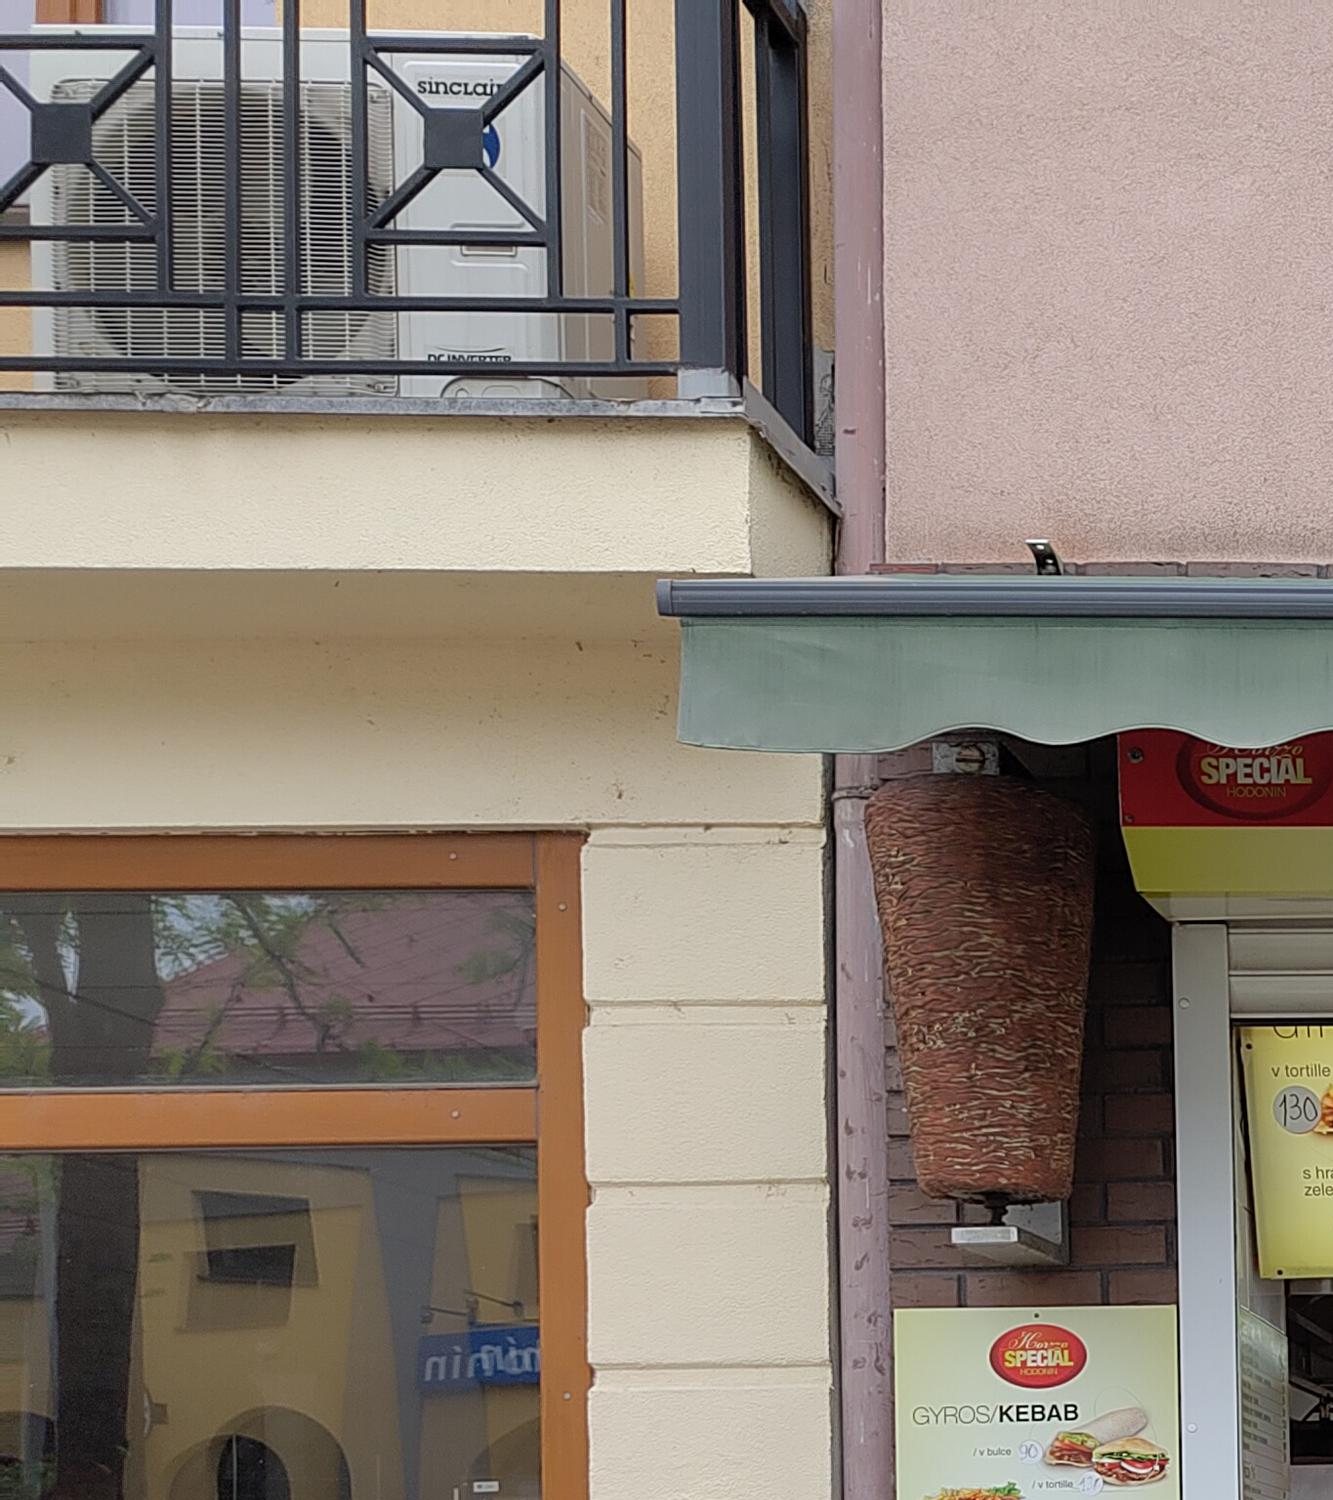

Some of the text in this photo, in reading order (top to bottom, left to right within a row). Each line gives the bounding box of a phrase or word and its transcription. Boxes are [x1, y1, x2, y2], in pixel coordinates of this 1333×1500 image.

[418, 77, 504, 97] sinclai
[1200, 757, 1312, 784] SPECIAL
[1272, 1063, 1331, 1077] v tortille
[1278, 1094, 1318, 1127] 130
[1303, 1169, 1312, 1179] s
[1004, 1349, 1074, 1367] SPECIAL
[912, 1404, 1079, 1425] GYROS/KEBAB
[979, 1447, 1011, 1457] v bulce
[1045, 1479, 1073, 1489] tortille
